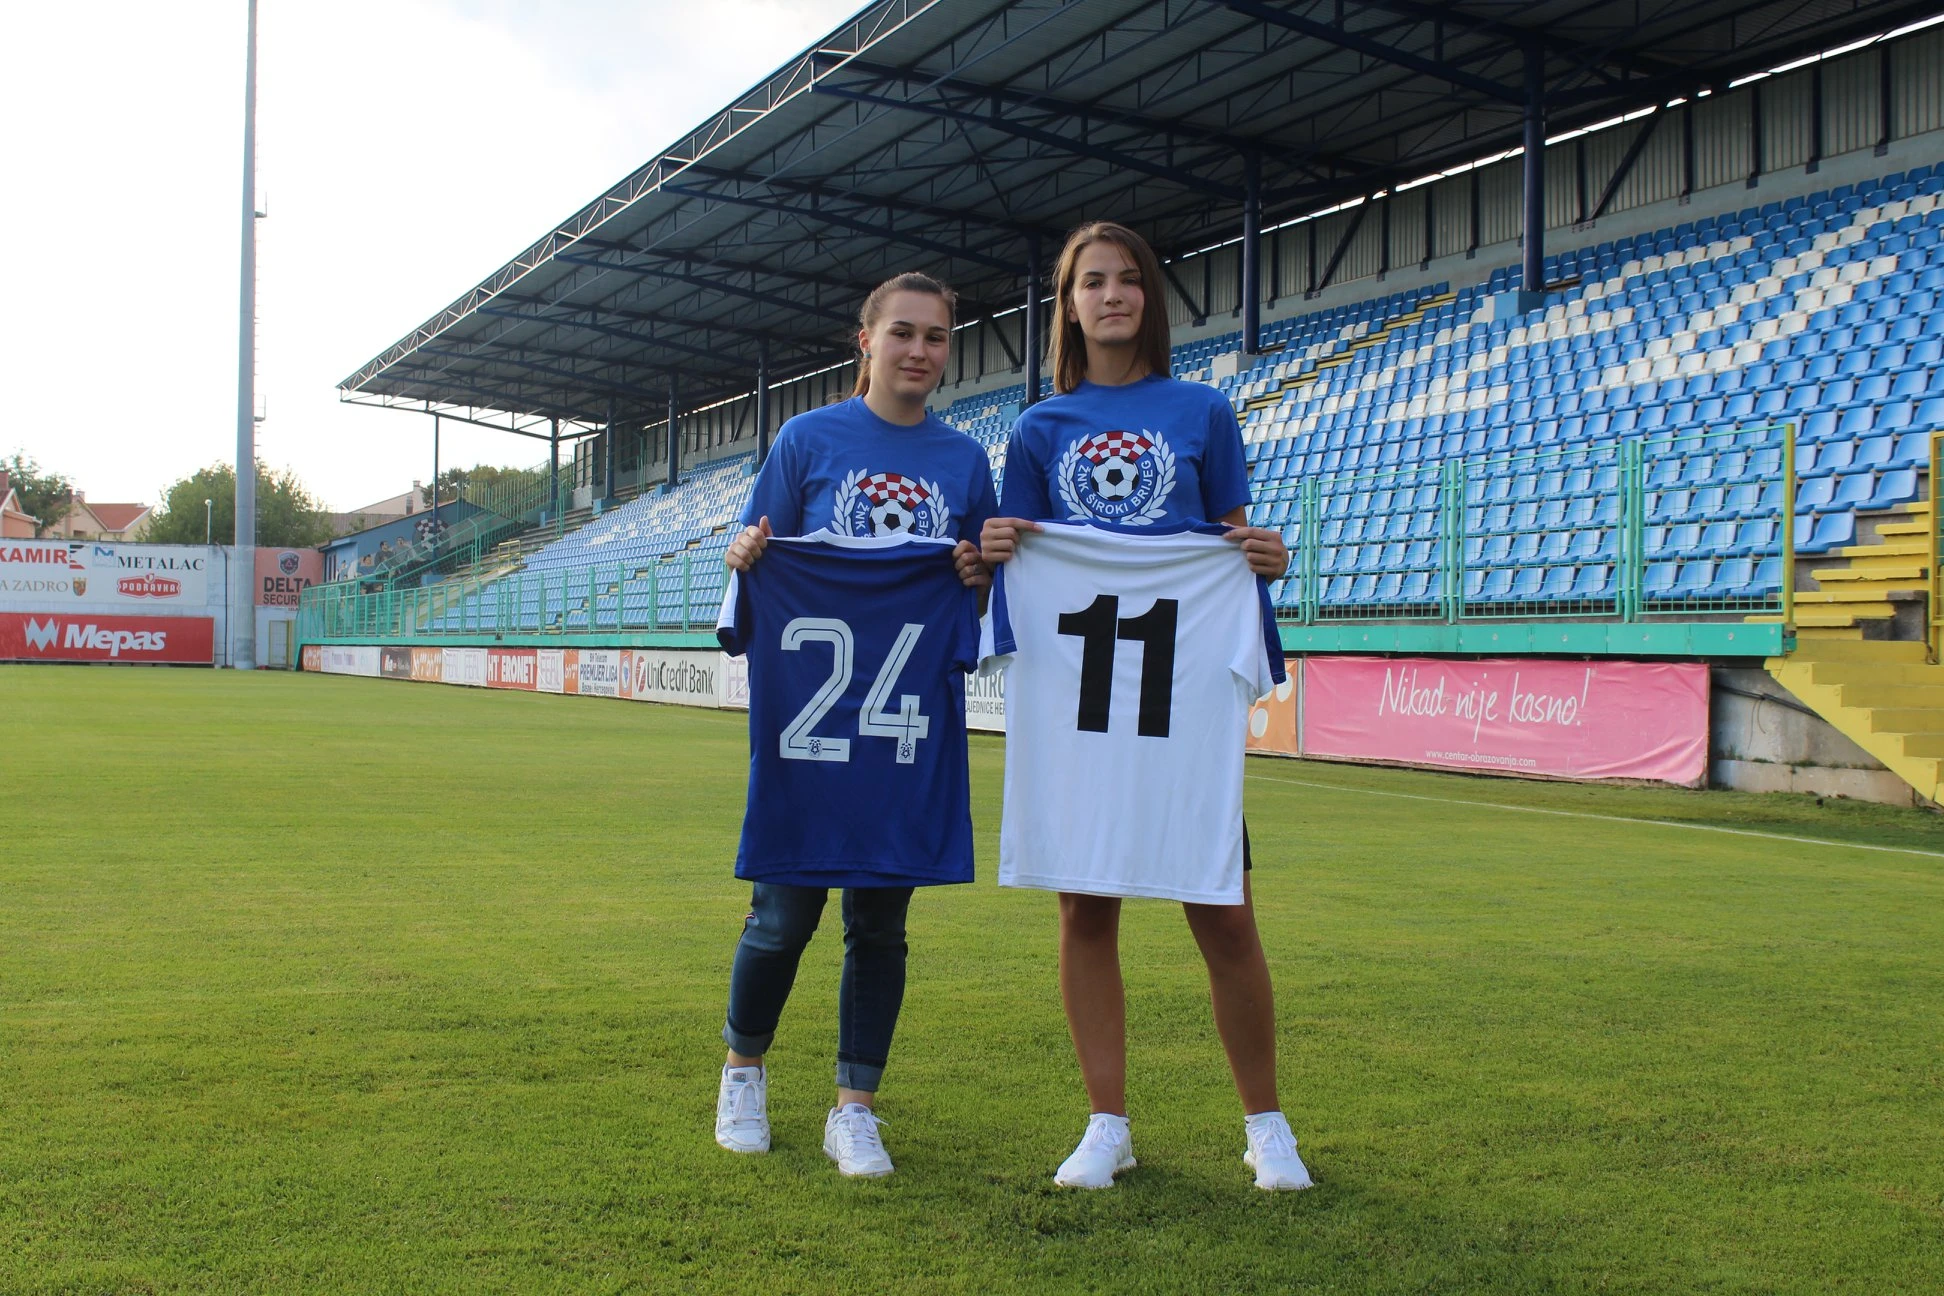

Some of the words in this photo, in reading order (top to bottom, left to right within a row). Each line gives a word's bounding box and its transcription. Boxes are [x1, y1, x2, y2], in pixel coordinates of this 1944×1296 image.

[1077, 464, 1091, 493] ŽNK
[1086, 492, 1129, 515] ŠIROKI
[1131, 460, 1153, 508] BRIJEG
[855, 501, 870, 530] ŽNK
[117, 556, 205, 571] METALAC
[12, 580, 69, 592] ZADRO
[122, 582, 177, 593] PODRAVKA
[263, 576, 312, 593] DELTA
[64, 623, 166, 657] Mepas
[488, 655, 499, 682] HT
[501, 655, 535, 684] ERONET
[1057, 594, 1179, 738] 11
[779, 617, 930, 764] 24
[1378, 667, 1446, 717] Nikad
[1455, 673, 1498, 744] nije
[1508, 667, 1592, 727] kasno!
[1425, 750, 1536, 768] www.centar-obrazovanja.com
